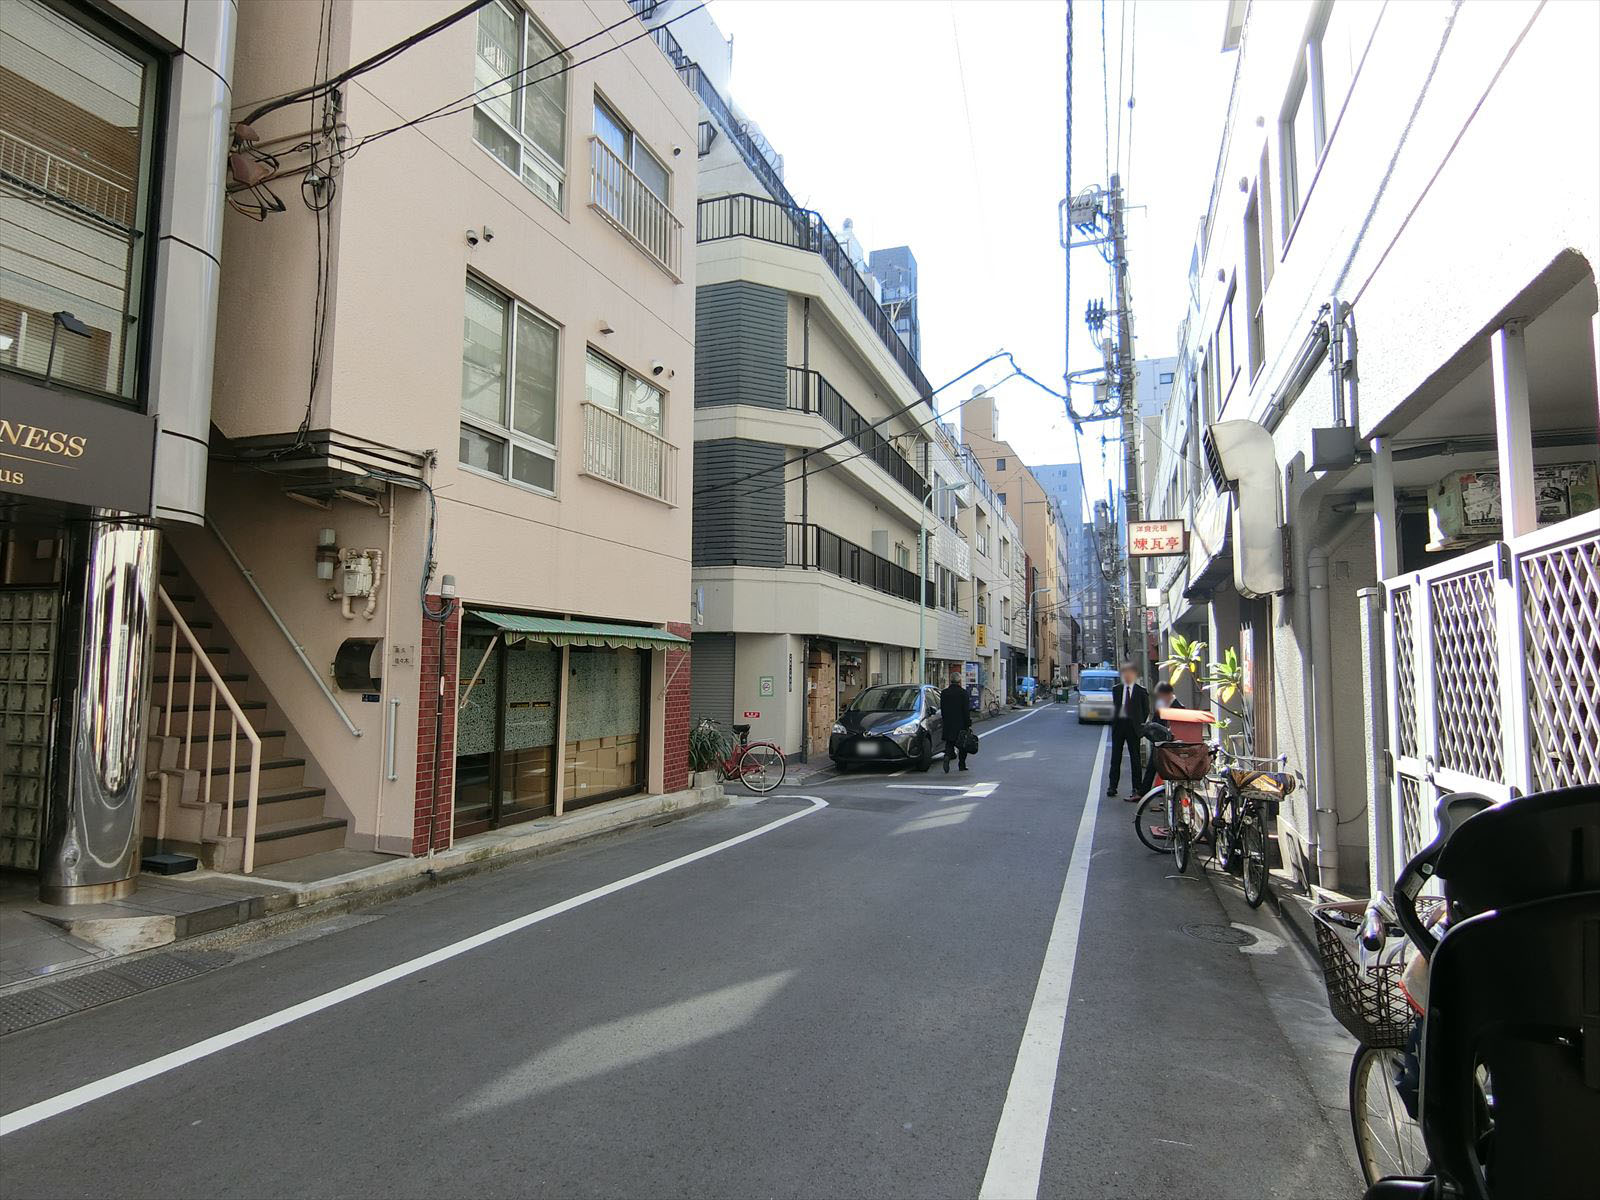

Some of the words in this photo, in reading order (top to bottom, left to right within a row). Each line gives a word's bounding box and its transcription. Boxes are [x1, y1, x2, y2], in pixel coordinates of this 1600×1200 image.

[0, 420, 87, 458] NESS
[0, 468, 24, 485] us
[1136, 524, 1168, 532] 洋食元祖
[1134, 536, 1179, 551] 煉瓦亭
